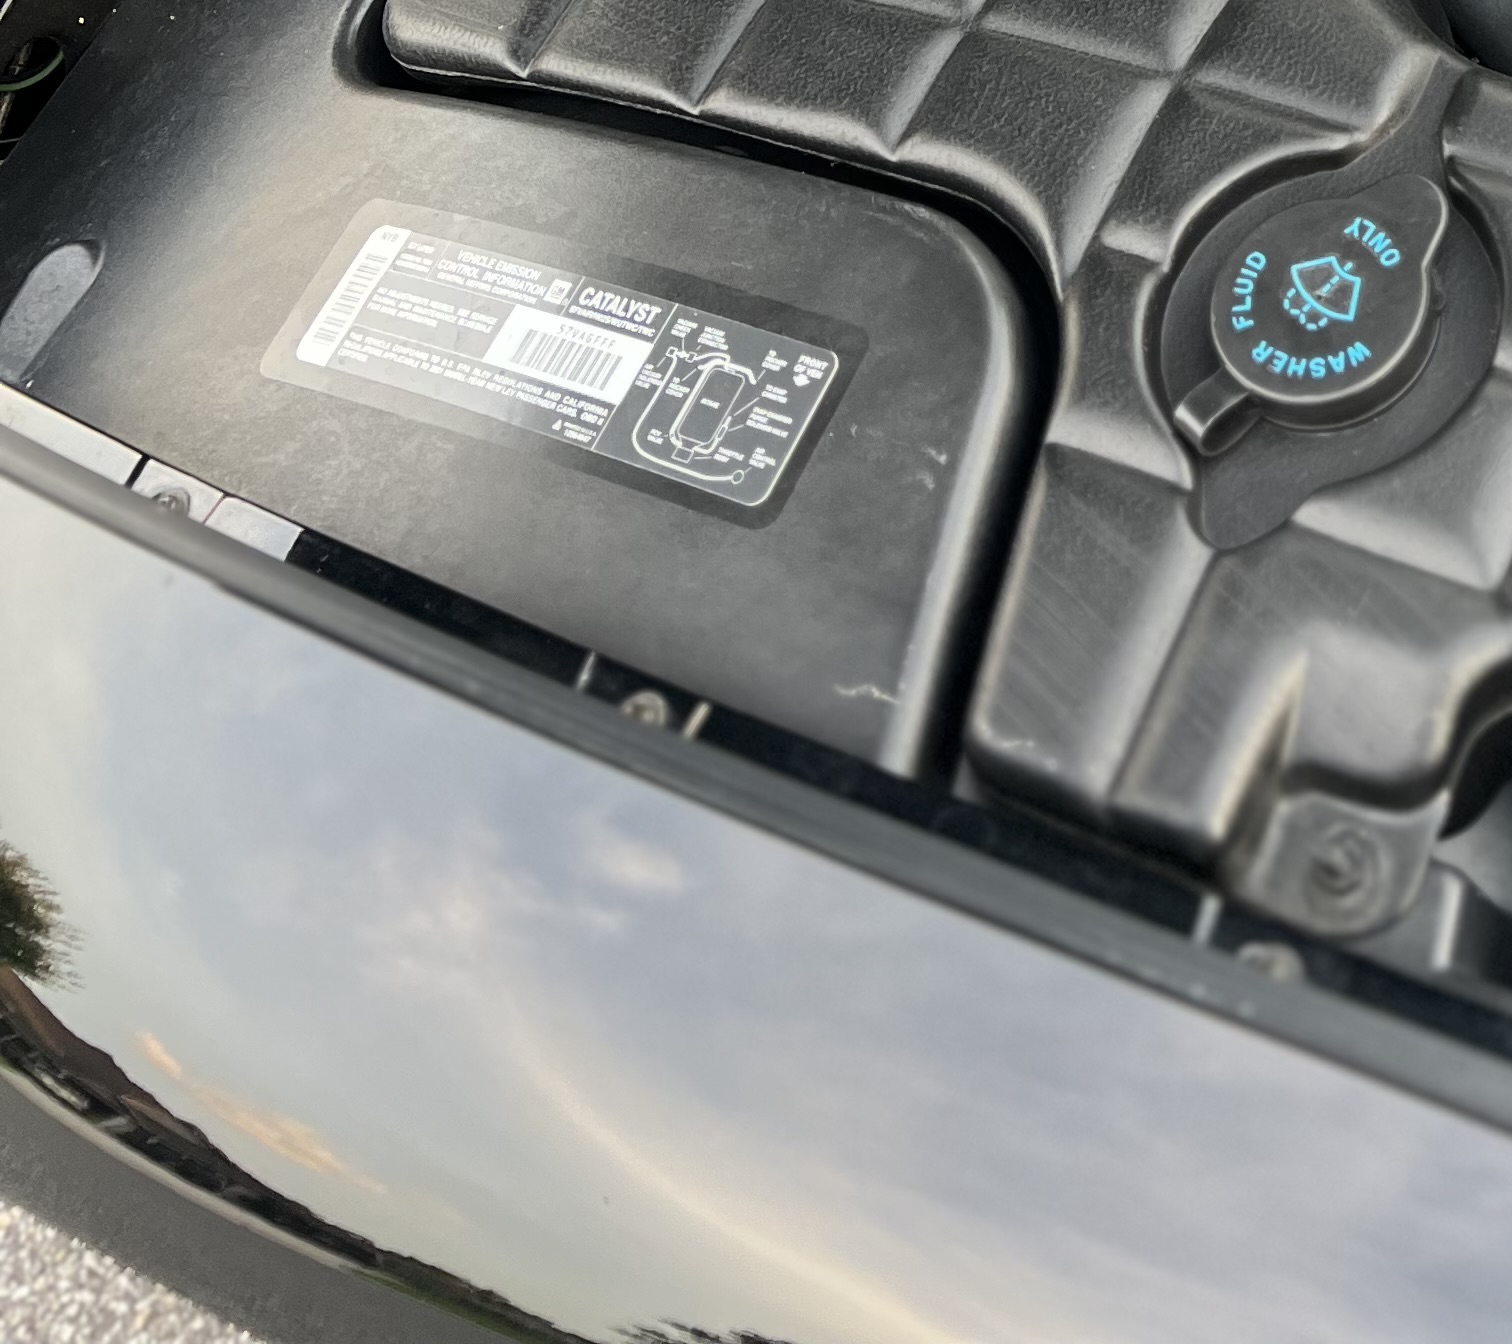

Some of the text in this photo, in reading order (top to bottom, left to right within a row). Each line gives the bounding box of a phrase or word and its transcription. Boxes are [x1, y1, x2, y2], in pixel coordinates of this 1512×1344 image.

[436, 258, 481, 278] CONTROL
[481, 270, 547, 296] INFORMATION
[455, 249, 496, 268] VEHICLE
[494, 260, 542, 281] EMISSION
[575, 285, 663, 325] CATALYST
[1231, 216, 1402, 379] WASHER FLUID ONLY
[793, 364, 807, 375] OF
[799, 355, 829, 371] FRONT
